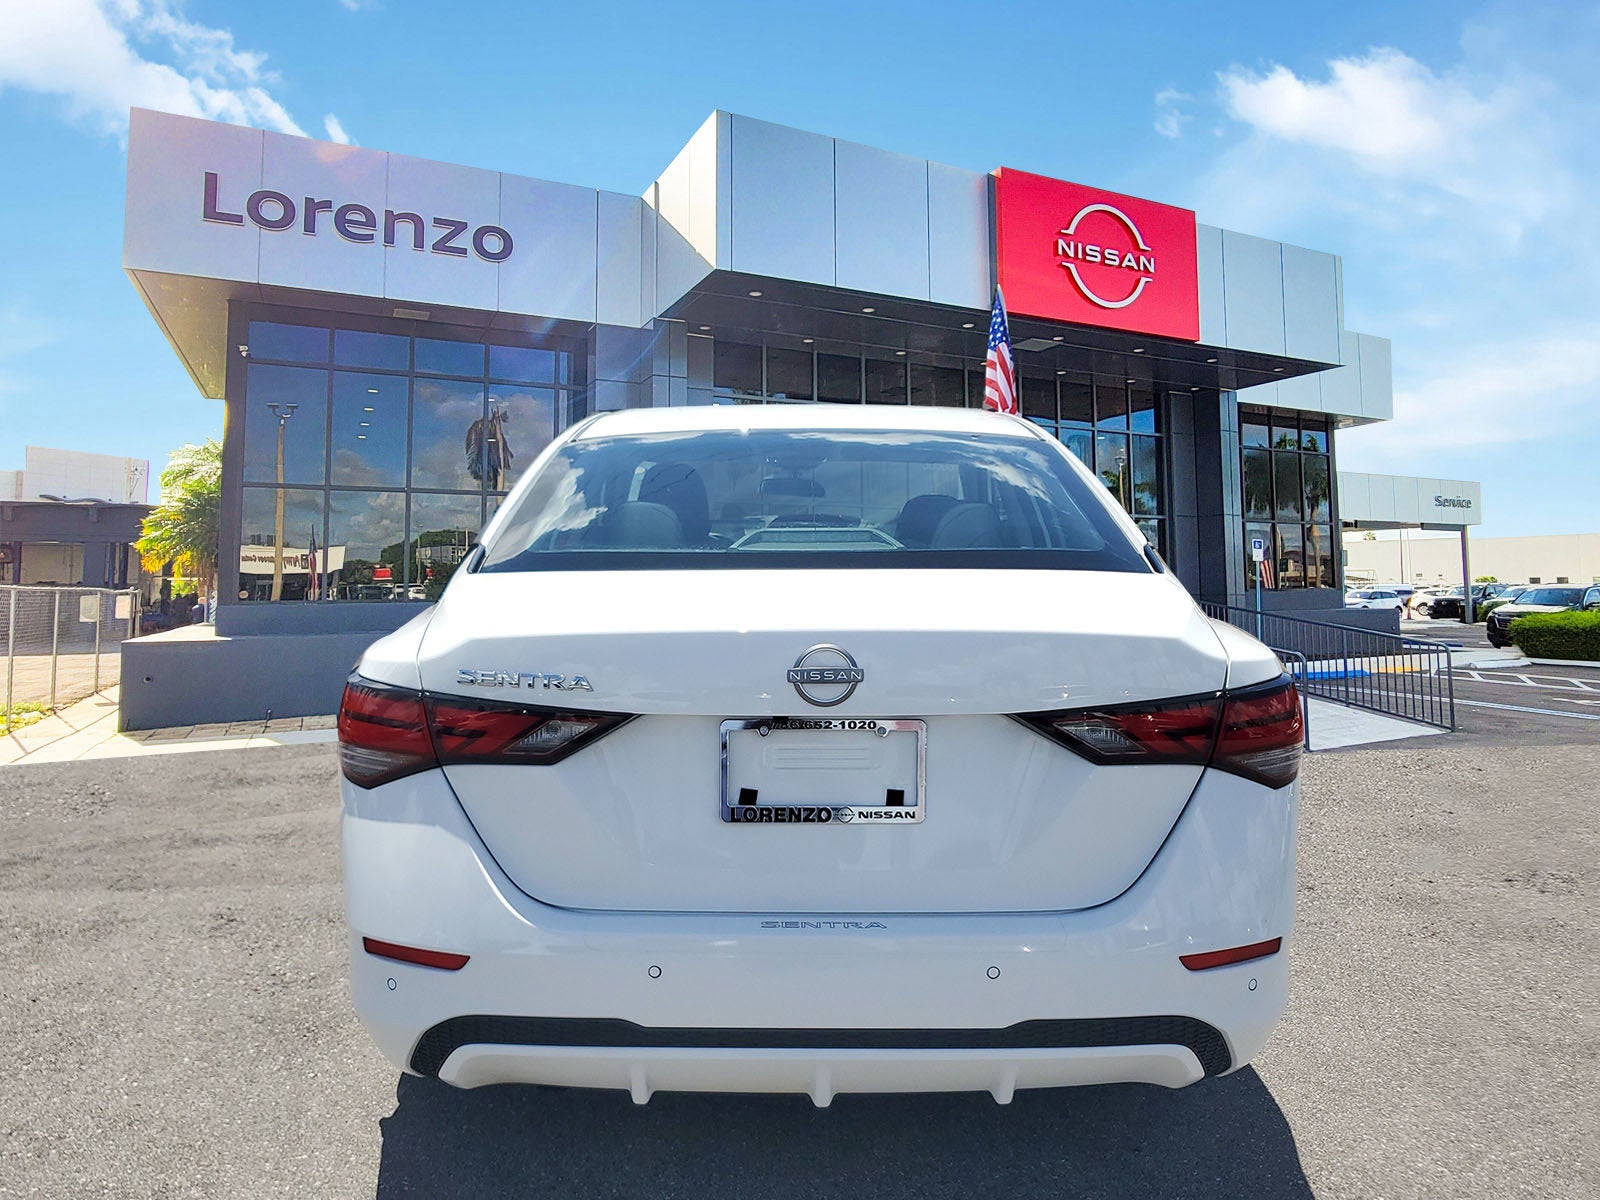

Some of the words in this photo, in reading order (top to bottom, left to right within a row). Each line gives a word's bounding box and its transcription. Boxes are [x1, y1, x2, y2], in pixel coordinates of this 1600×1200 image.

[202, 171, 514, 262] Lorenzo
[1057, 238, 1155, 273] NISSAN
[1434, 495, 1472, 509] Service
[457, 669, 594, 692] SENTRA
[789, 671, 862, 681] NISSAN
[730, 807, 832, 823] LORENZO
[858, 811, 916, 819] NISSAN
[761, 921, 888, 929] SENTRA
